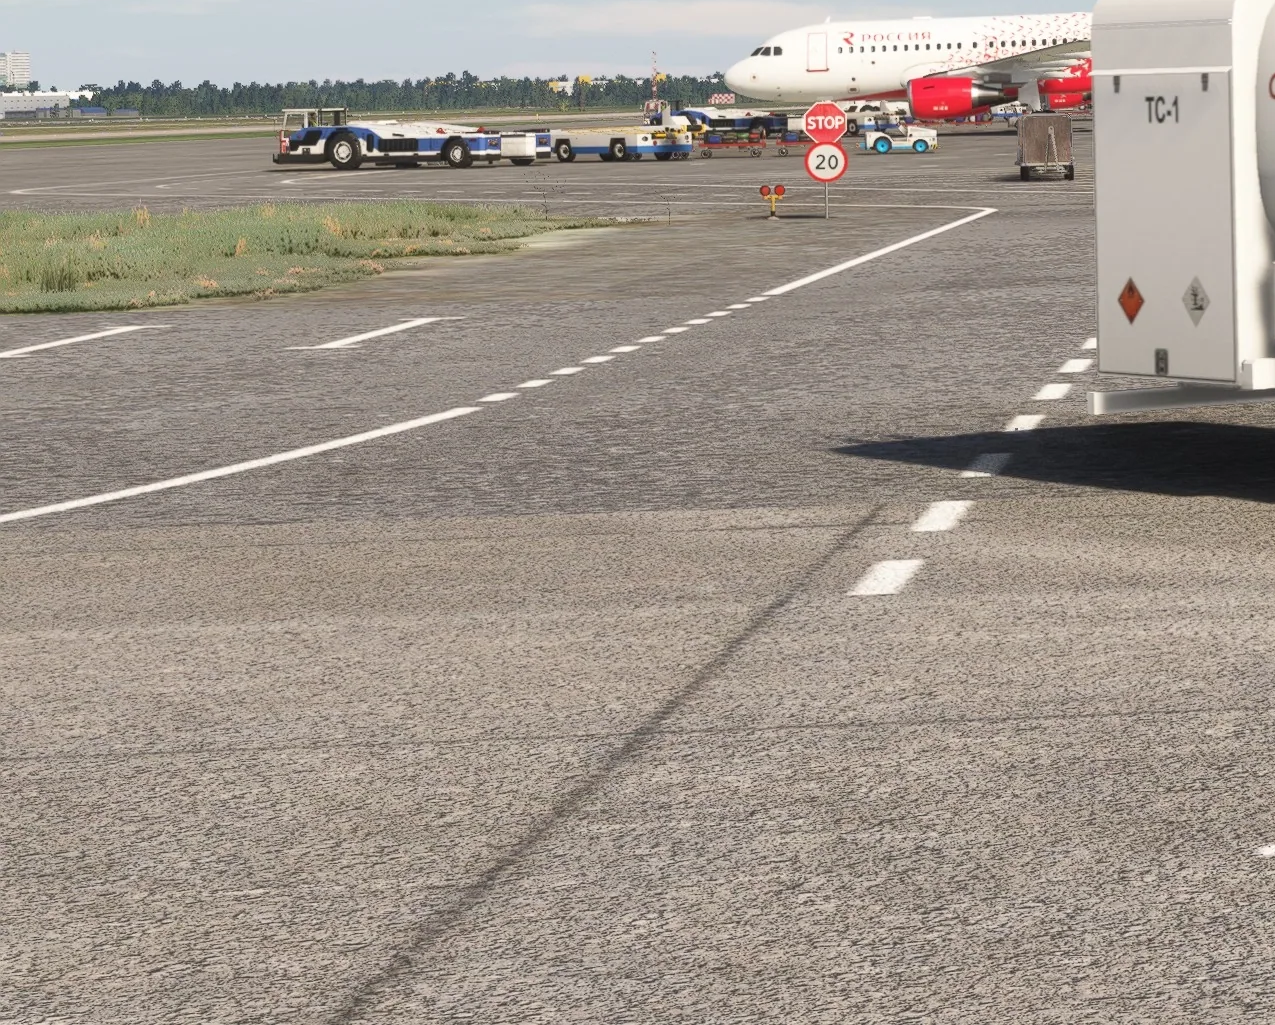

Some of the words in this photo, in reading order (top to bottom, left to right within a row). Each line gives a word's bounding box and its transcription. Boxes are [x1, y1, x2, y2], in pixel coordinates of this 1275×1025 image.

[861, 31, 931, 43] РОССИЯ
[1145, 96, 1179, 124] ТС-1
[807, 115, 845, 130] STOP
[815, 154, 839, 170] 20
